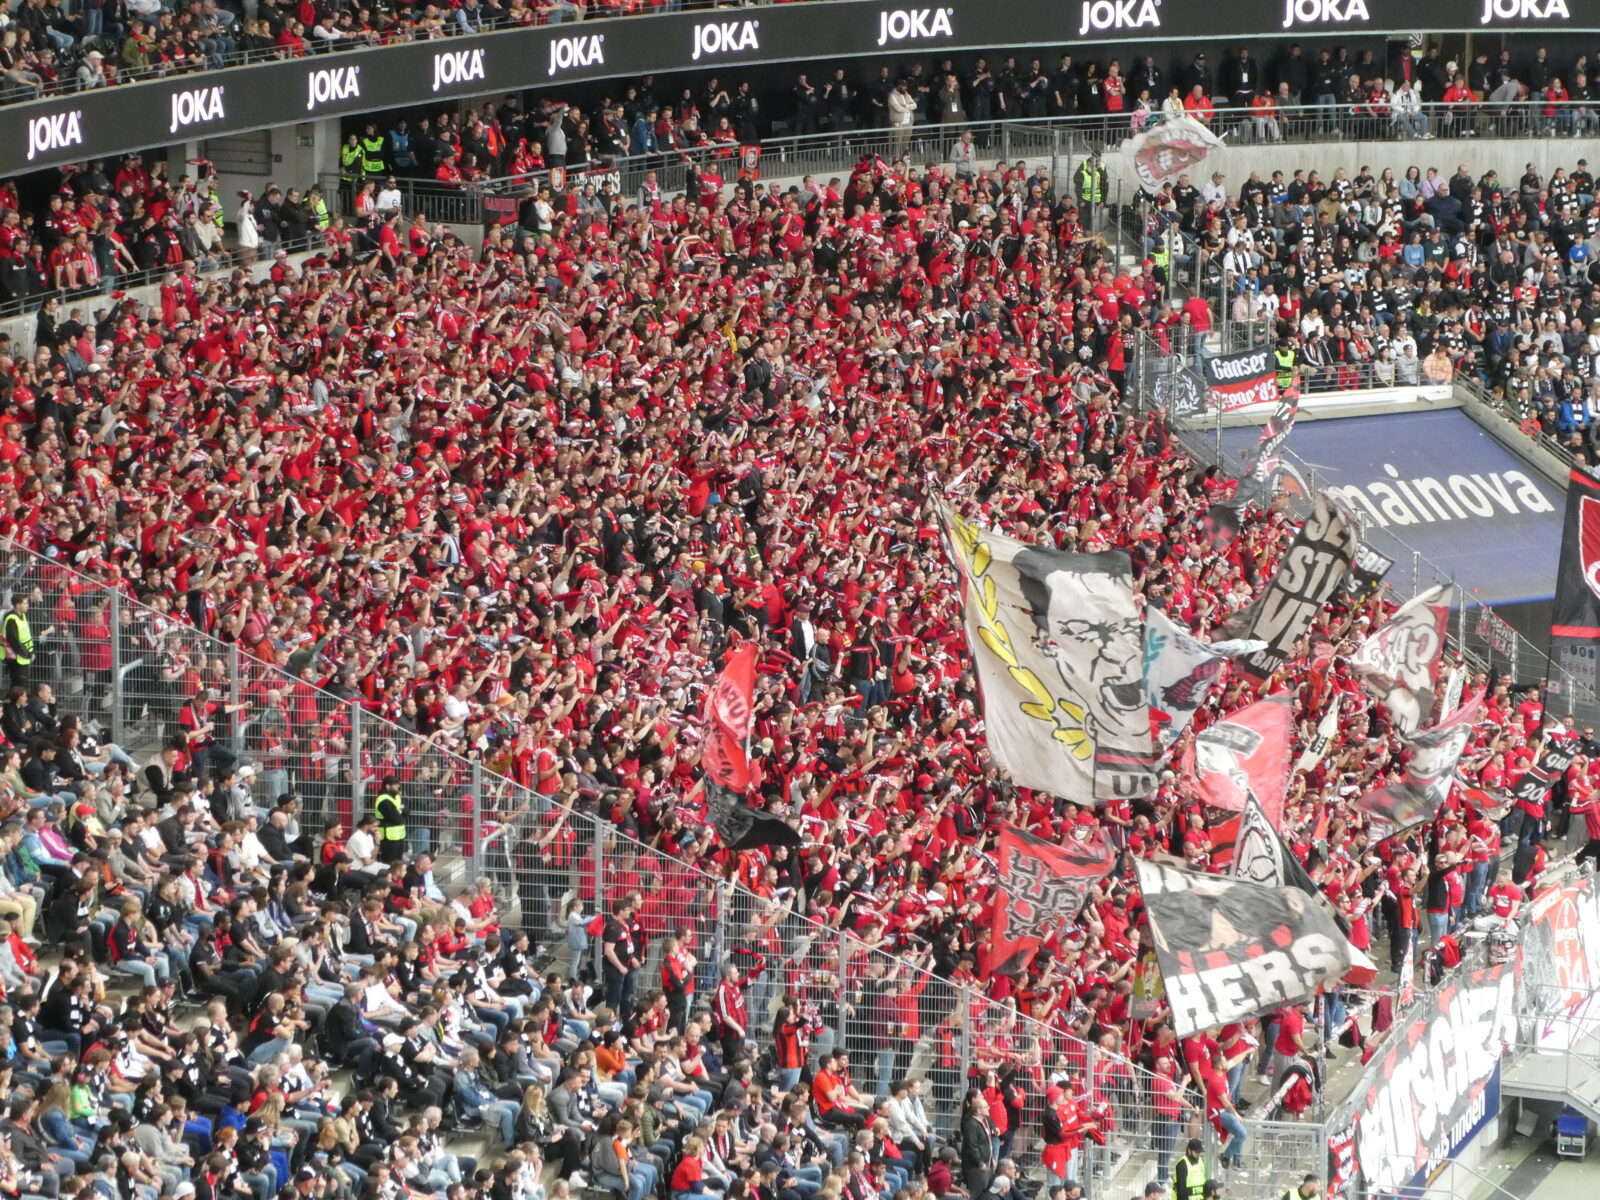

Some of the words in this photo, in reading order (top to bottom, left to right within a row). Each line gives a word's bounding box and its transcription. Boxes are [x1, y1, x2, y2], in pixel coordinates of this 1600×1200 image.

[878, 8, 953, 45] JOKA
[1079, 0, 1160, 35] JOKA
[1283, 0, 1369, 28] JOKA
[549, 35, 604, 75] JOKA
[692, 21, 758, 60] JOKA
[307, 66, 359, 110] JOKA
[433, 49, 484, 91] JOKA
[170, 86, 224, 133] JOKA
[27, 111, 81, 160] JOKA
[1210, 352, 1268, 380] Ganser
[1328, 463, 1556, 527] mainova
[1165, 933, 1352, 1040] HERS
